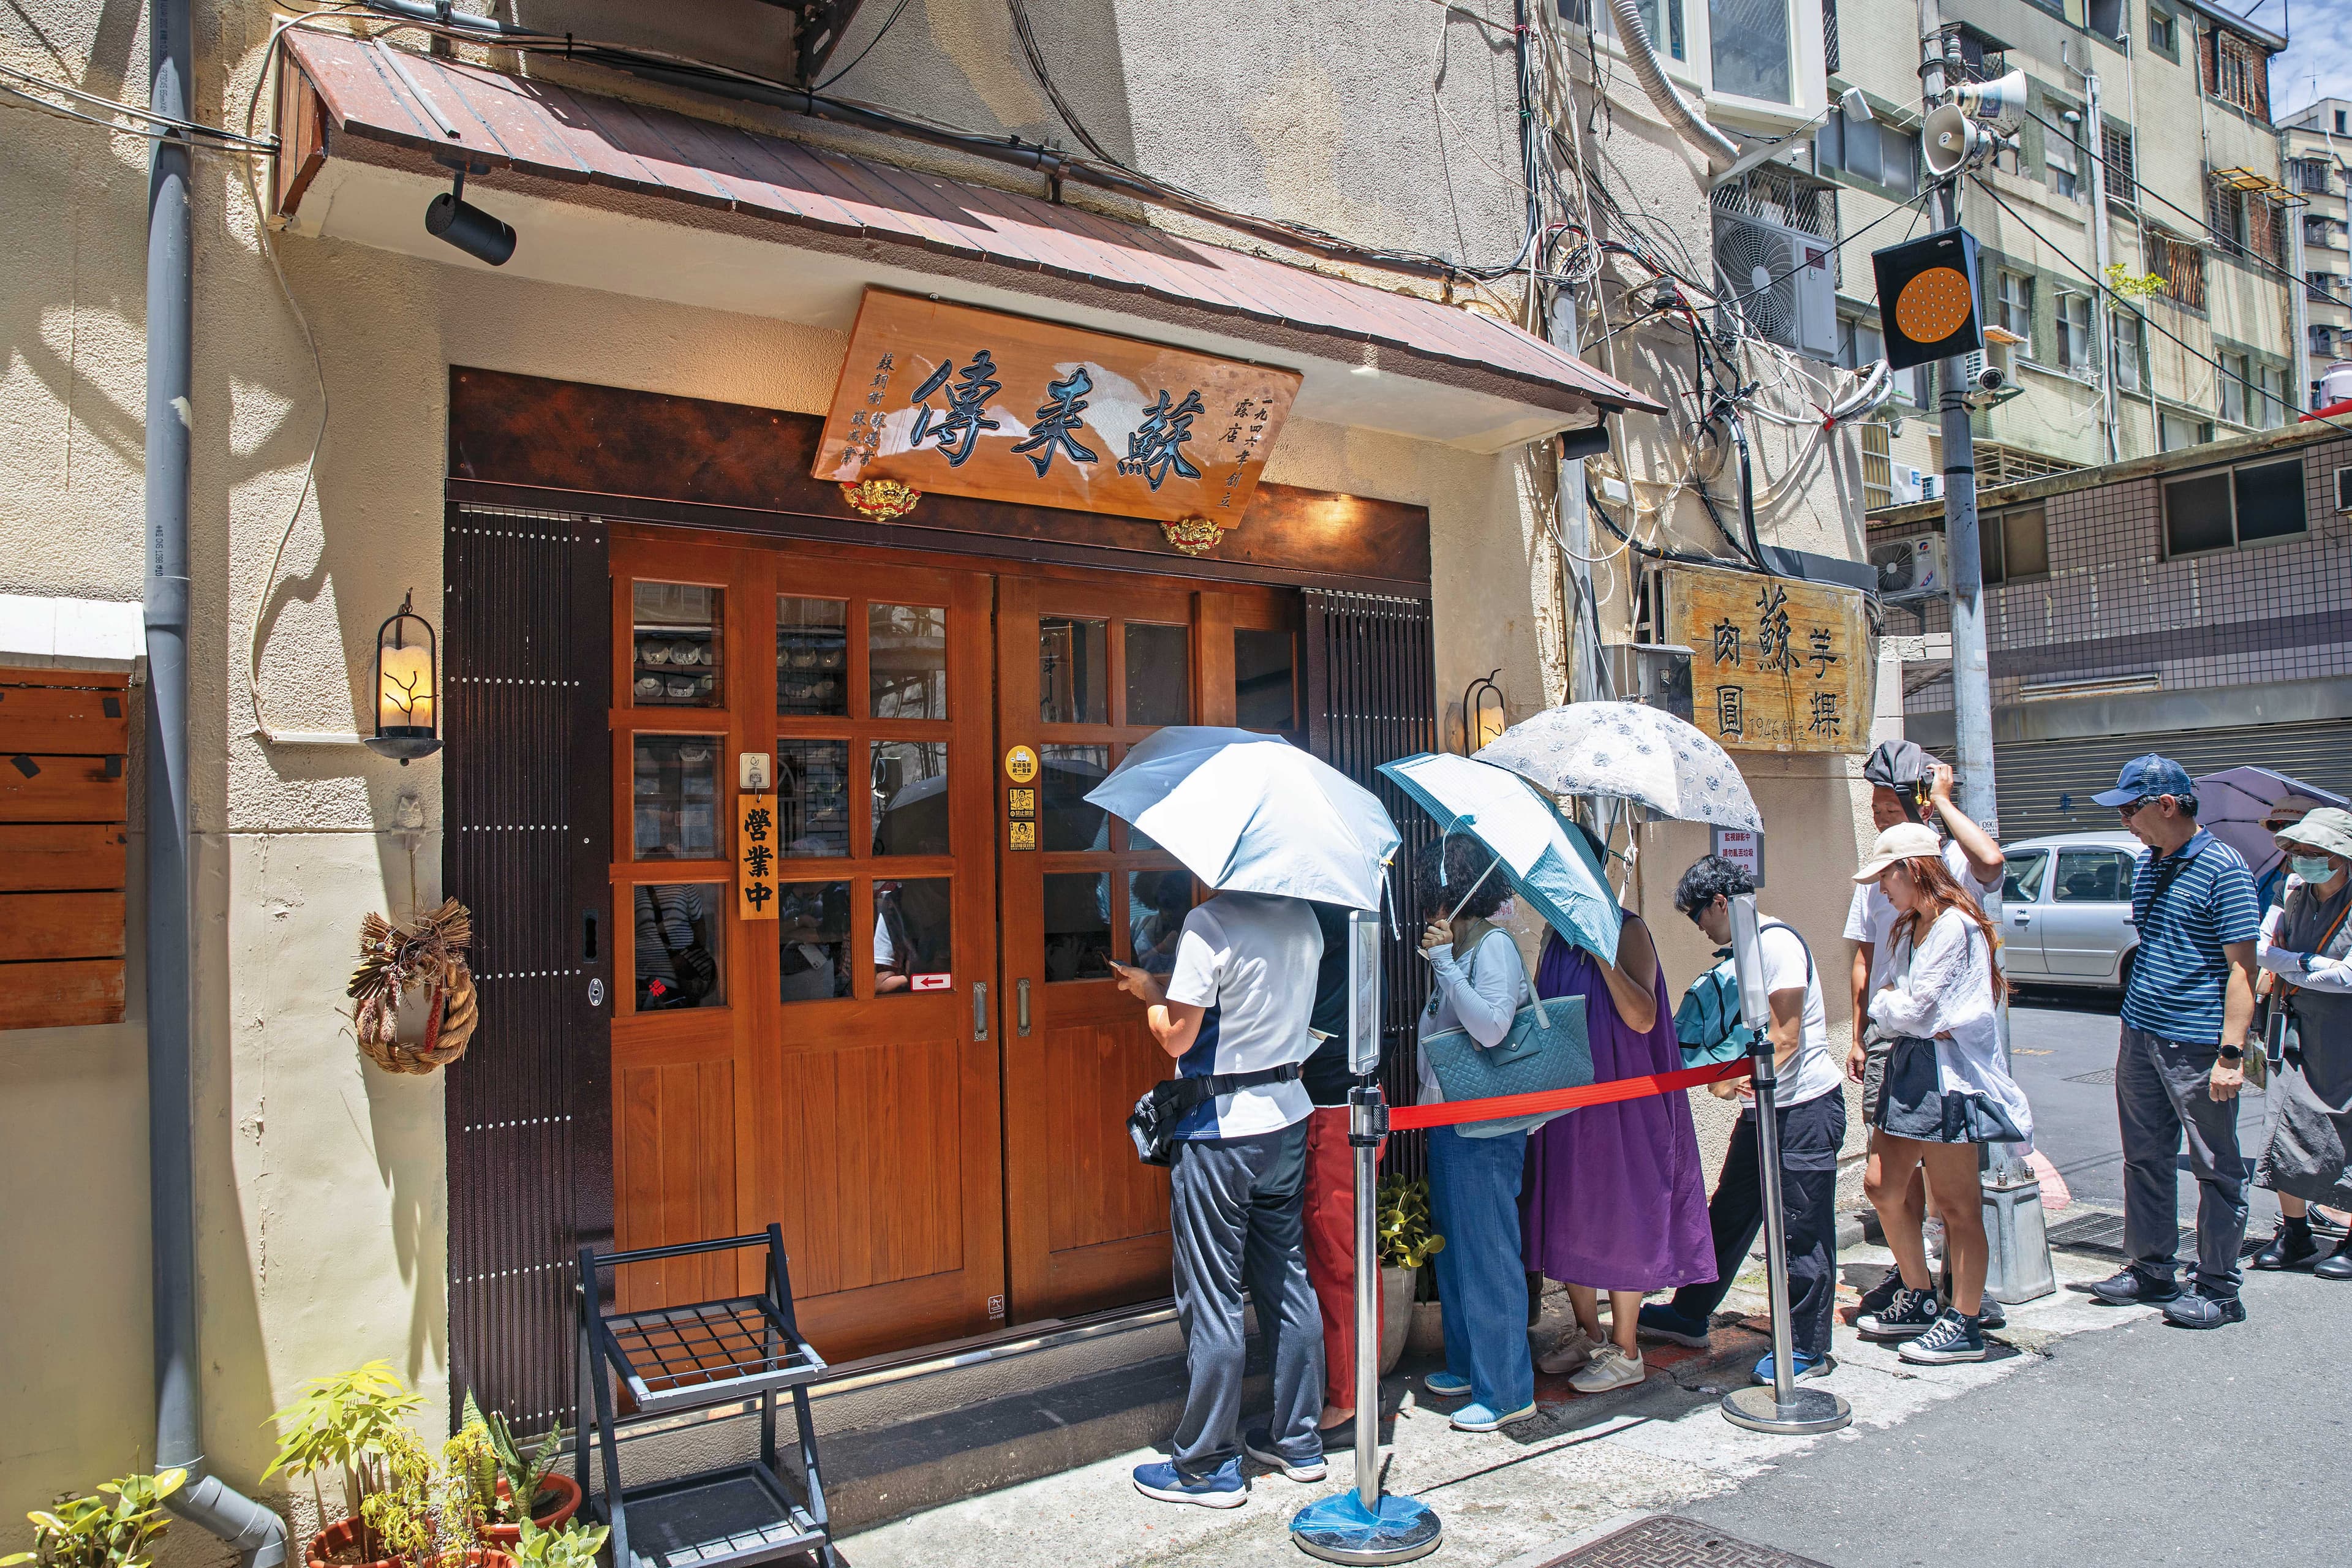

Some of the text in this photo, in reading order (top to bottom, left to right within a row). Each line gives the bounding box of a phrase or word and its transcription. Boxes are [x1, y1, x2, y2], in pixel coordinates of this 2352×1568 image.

[1714, 617, 1744, 736] 肉圓
[1755, 584, 1801, 676] 蘇
[1807, 628, 1841, 741] 芋粿
[744, 809, 772, 912] 營業中
[1724, 833, 1751, 842] 監視錄影中
